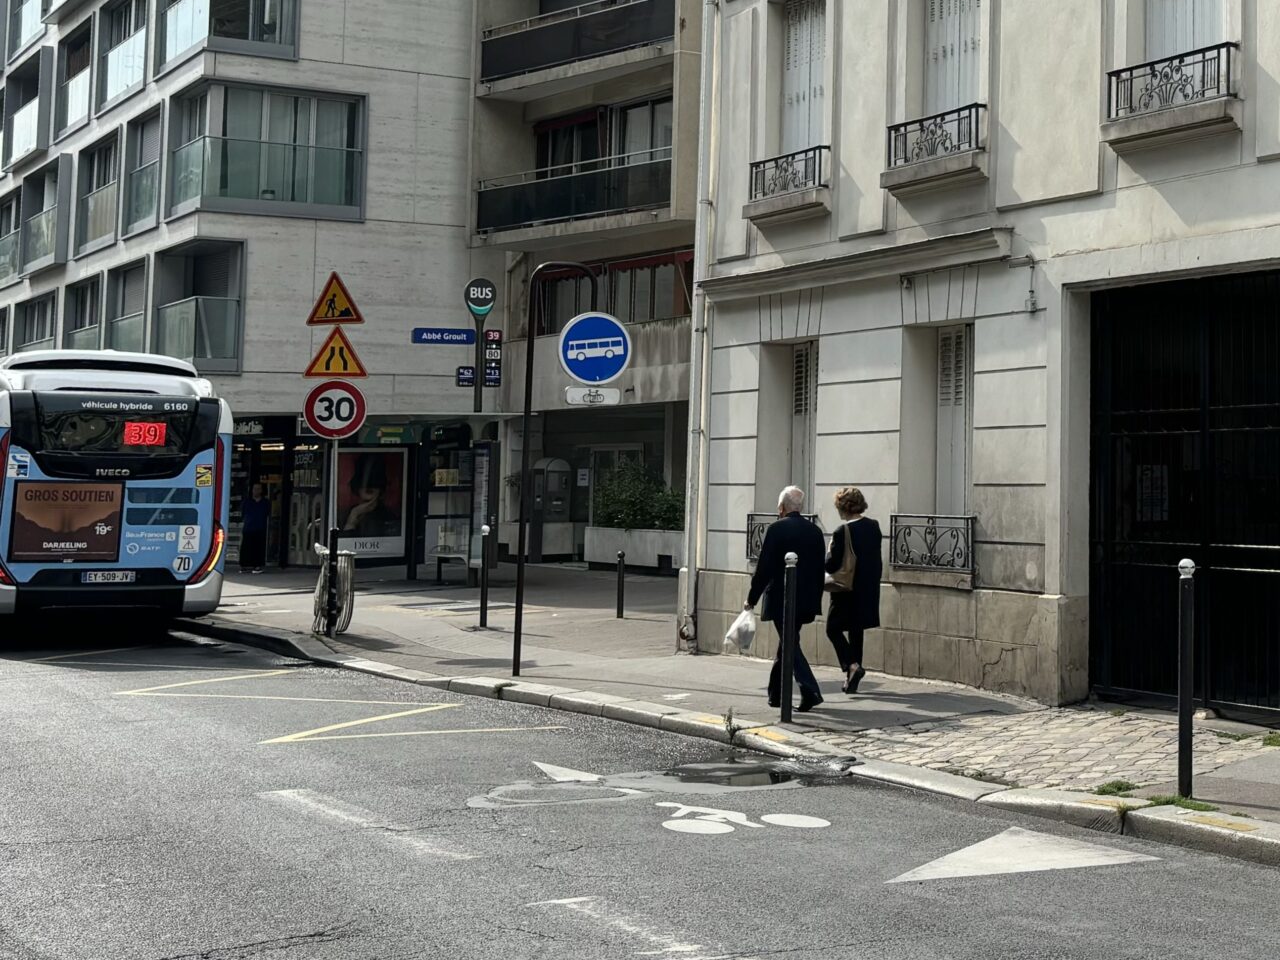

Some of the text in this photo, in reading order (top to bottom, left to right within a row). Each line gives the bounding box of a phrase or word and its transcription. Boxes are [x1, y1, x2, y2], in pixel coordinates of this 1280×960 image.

[470, 287, 492, 298] BUS
[421, 332, 467, 340] Abbé Groult
[487, 331, 499, 340] 39
[487, 350, 499, 358] 80
[81, 400, 188, 411] véhicule hybride 6160
[316, 396, 355, 422] 30
[128, 424, 161, 444] 39
[95, 468, 130, 477] IVECO
[25, 489, 114, 502] GROS SOUTIEN
[42, 541, 87, 549] DARJEELING
[354, 541, 380, 550] DIOR
[176, 556, 191, 572] 70
